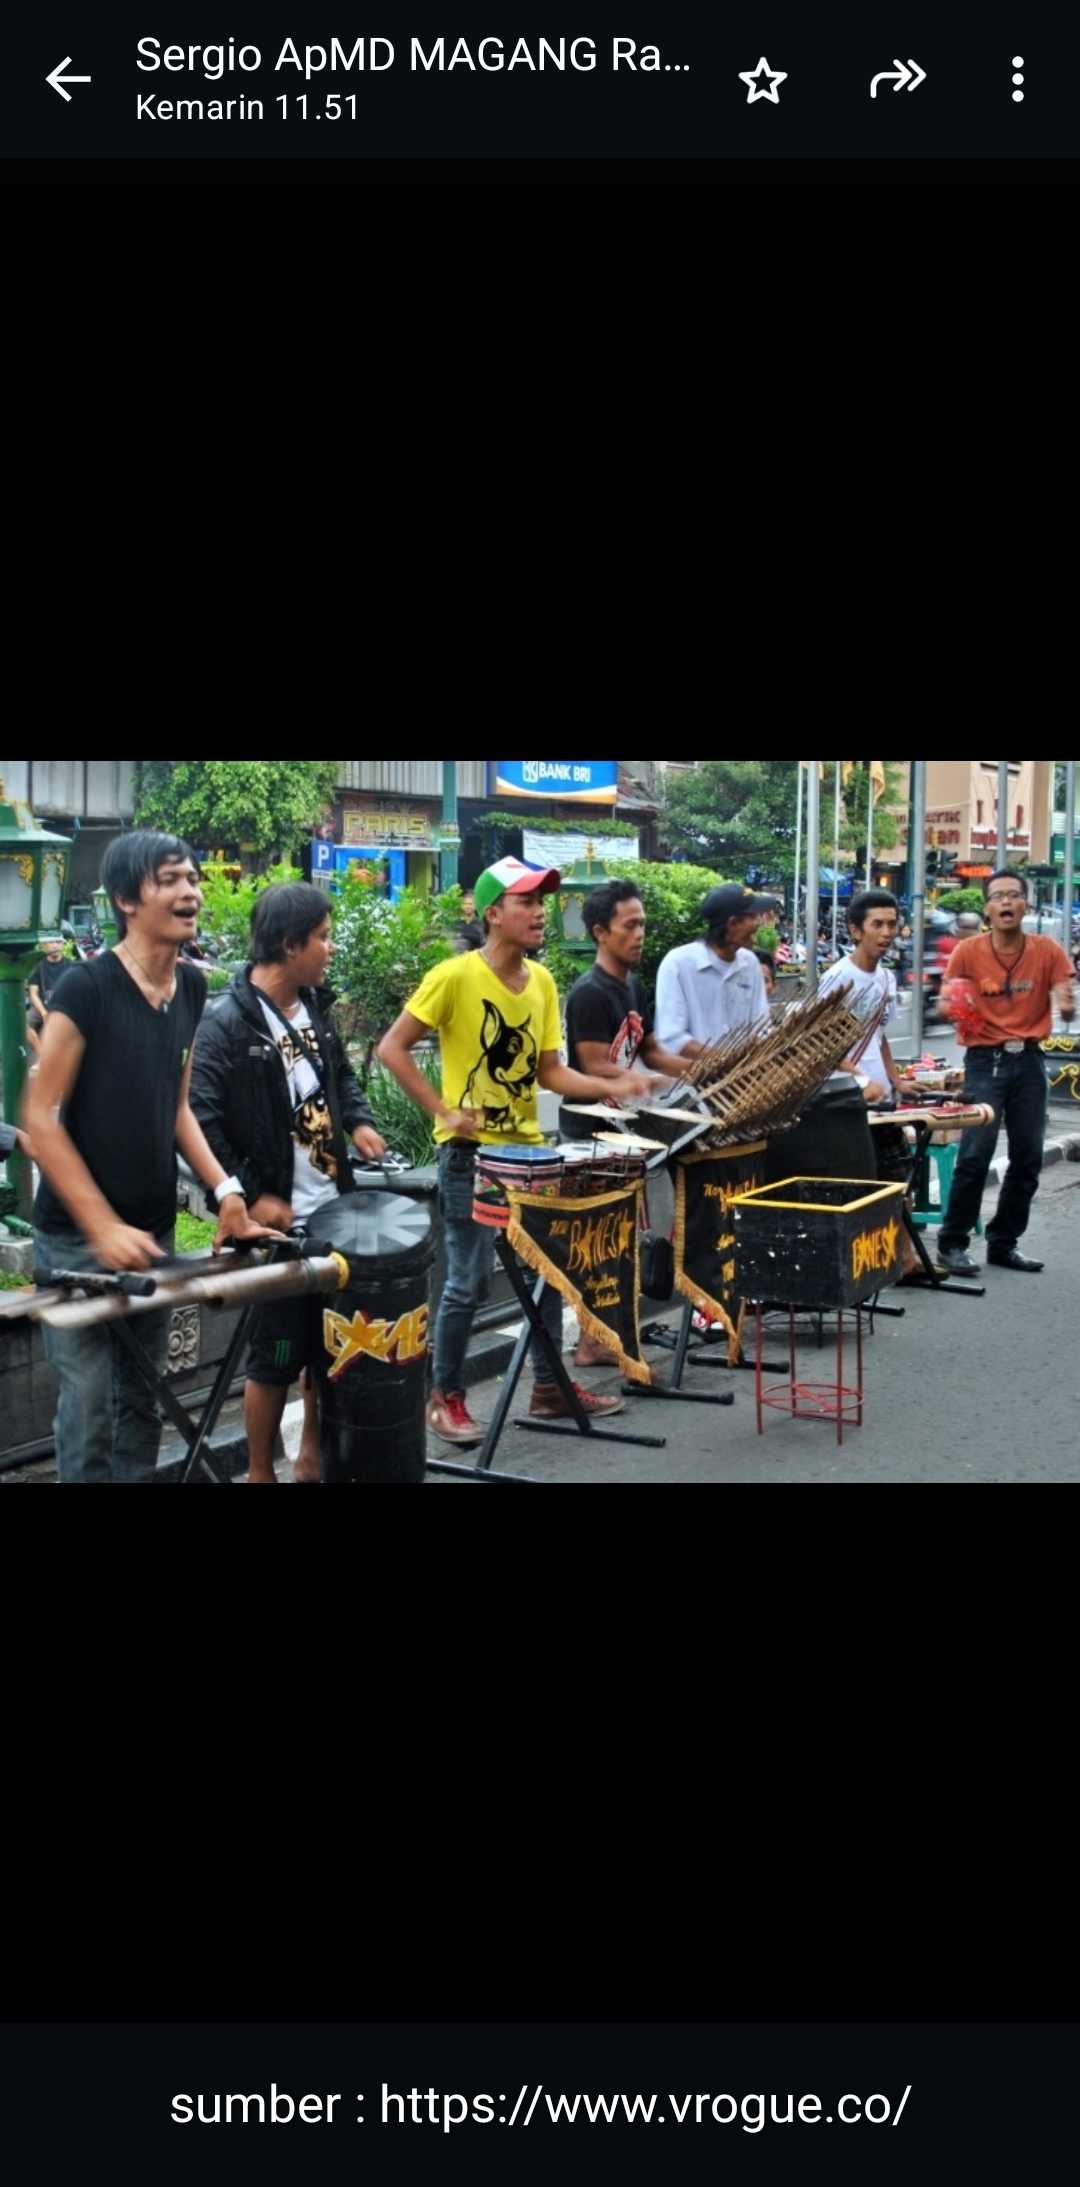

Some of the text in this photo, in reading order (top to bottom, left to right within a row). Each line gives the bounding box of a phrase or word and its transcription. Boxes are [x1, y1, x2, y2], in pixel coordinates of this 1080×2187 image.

[538, 761, 591, 783] BANK BRI
[344, 810, 427, 837] PARIS
[318, 845, 329, 867] P
